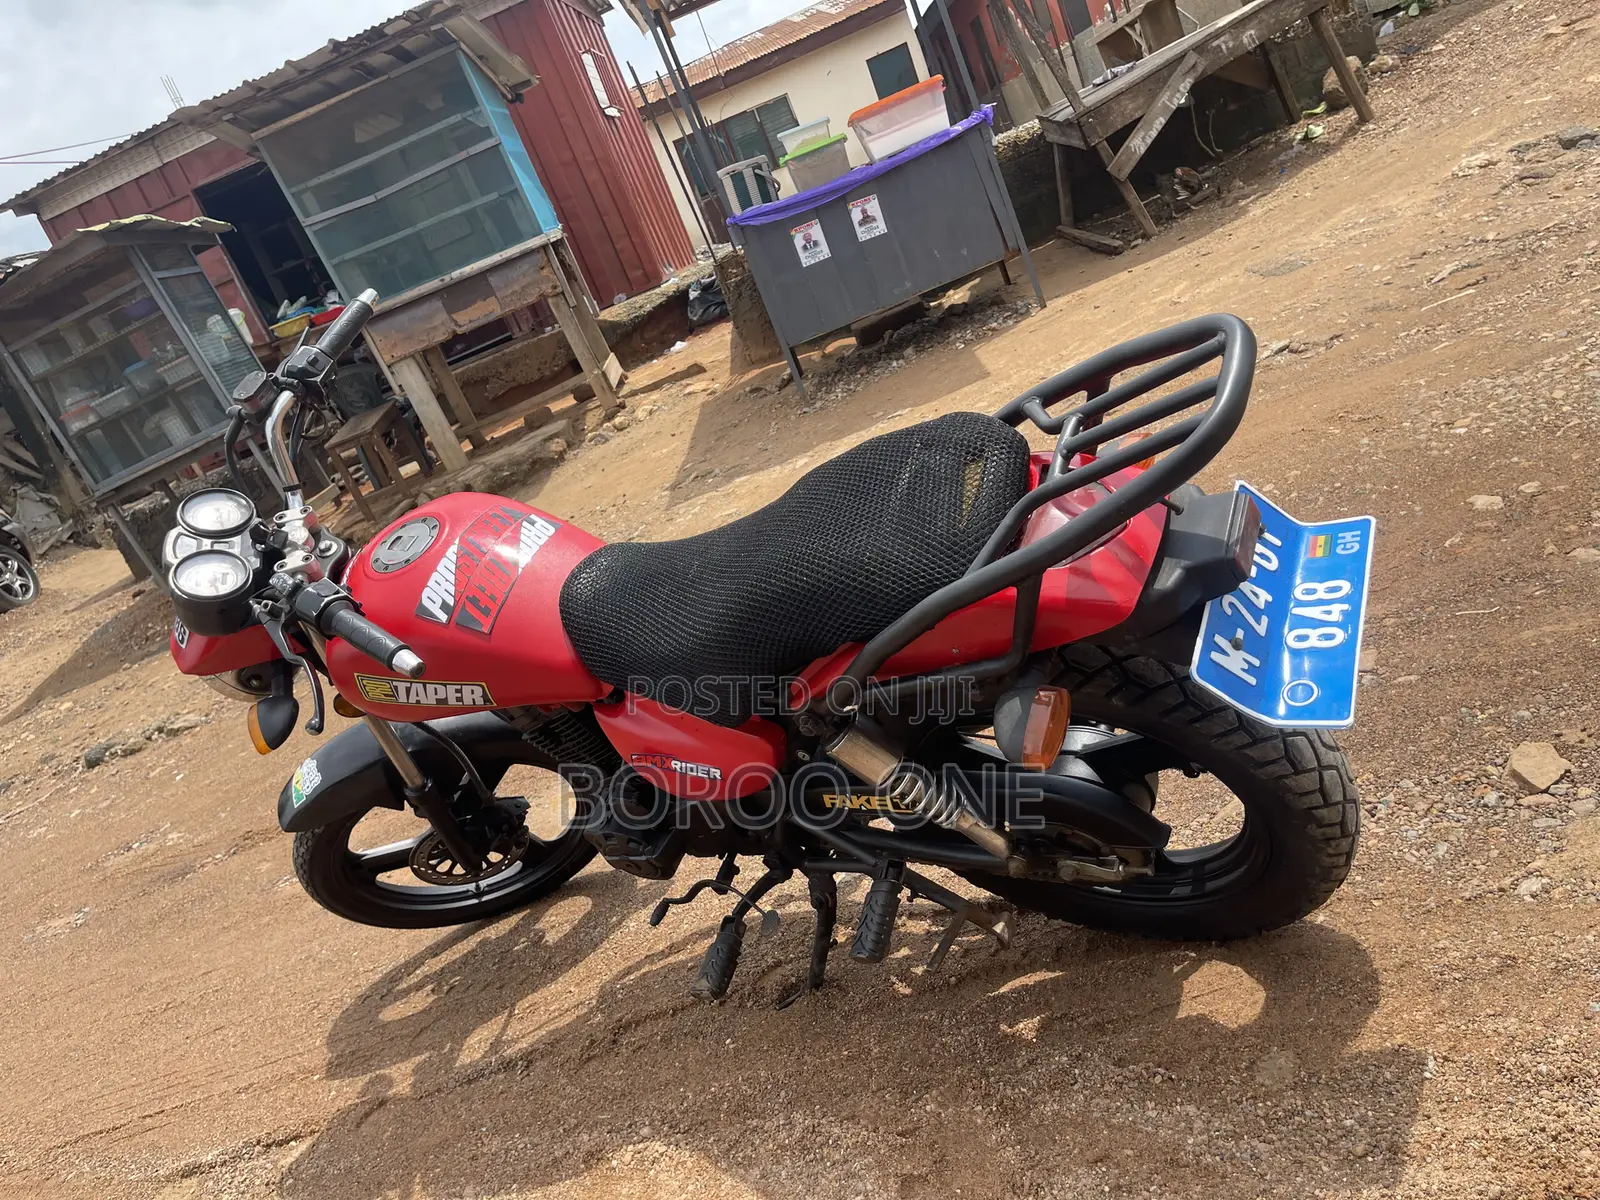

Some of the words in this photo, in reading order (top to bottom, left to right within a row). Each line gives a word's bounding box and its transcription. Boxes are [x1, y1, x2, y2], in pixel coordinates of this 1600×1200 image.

[1336, 530, 1362, 555] GH
[1285, 578, 1352, 650] 848
[362, 680, 397, 701] PRO
[392, 681, 484, 705] TAPER
[823, 795, 889, 809] FAKE
